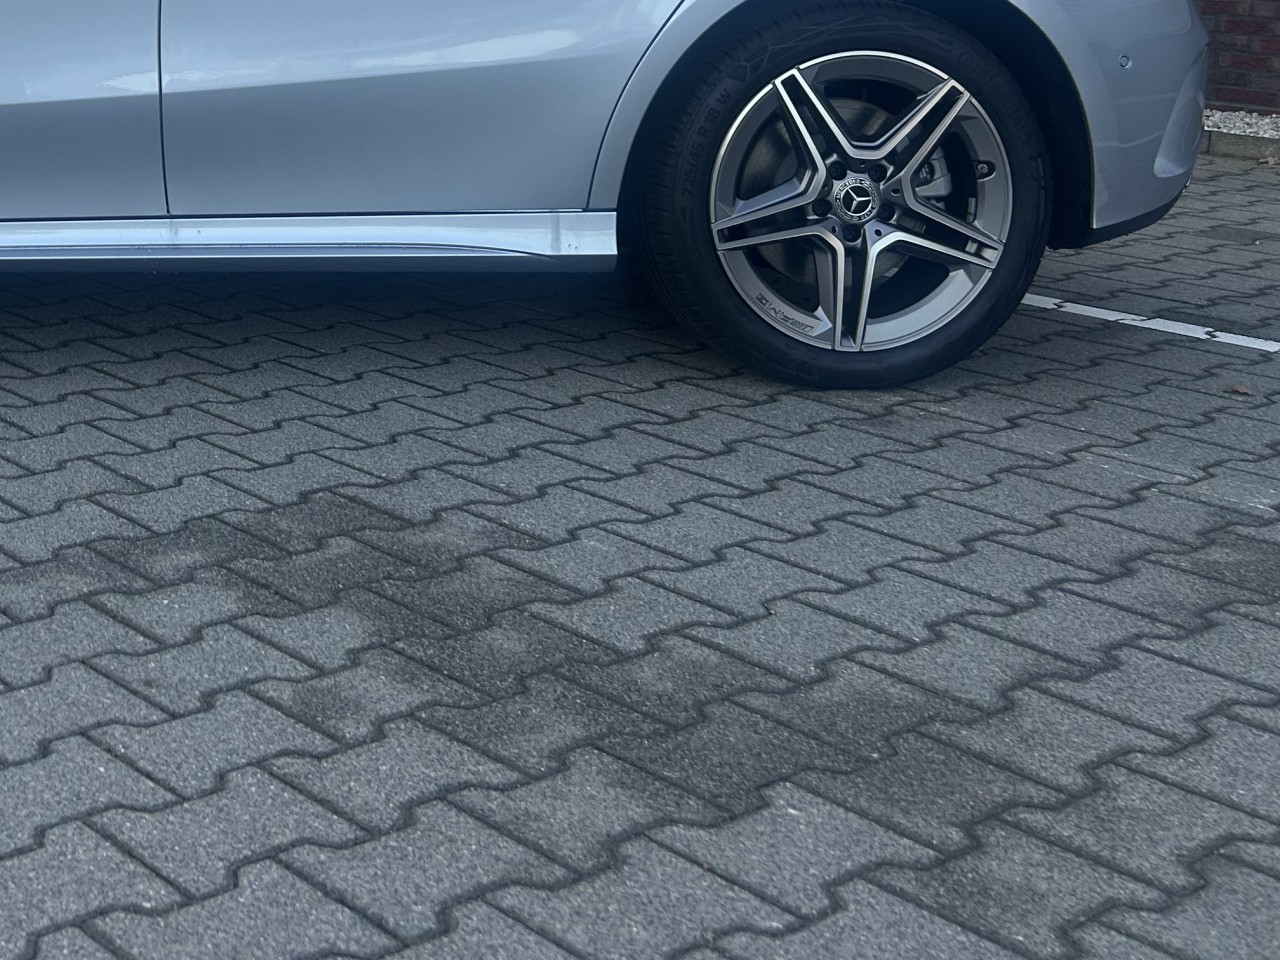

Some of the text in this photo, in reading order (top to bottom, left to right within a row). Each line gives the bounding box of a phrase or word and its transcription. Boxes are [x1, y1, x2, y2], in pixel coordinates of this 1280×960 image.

[681, 88, 733, 197] 225/45 R 18 W
